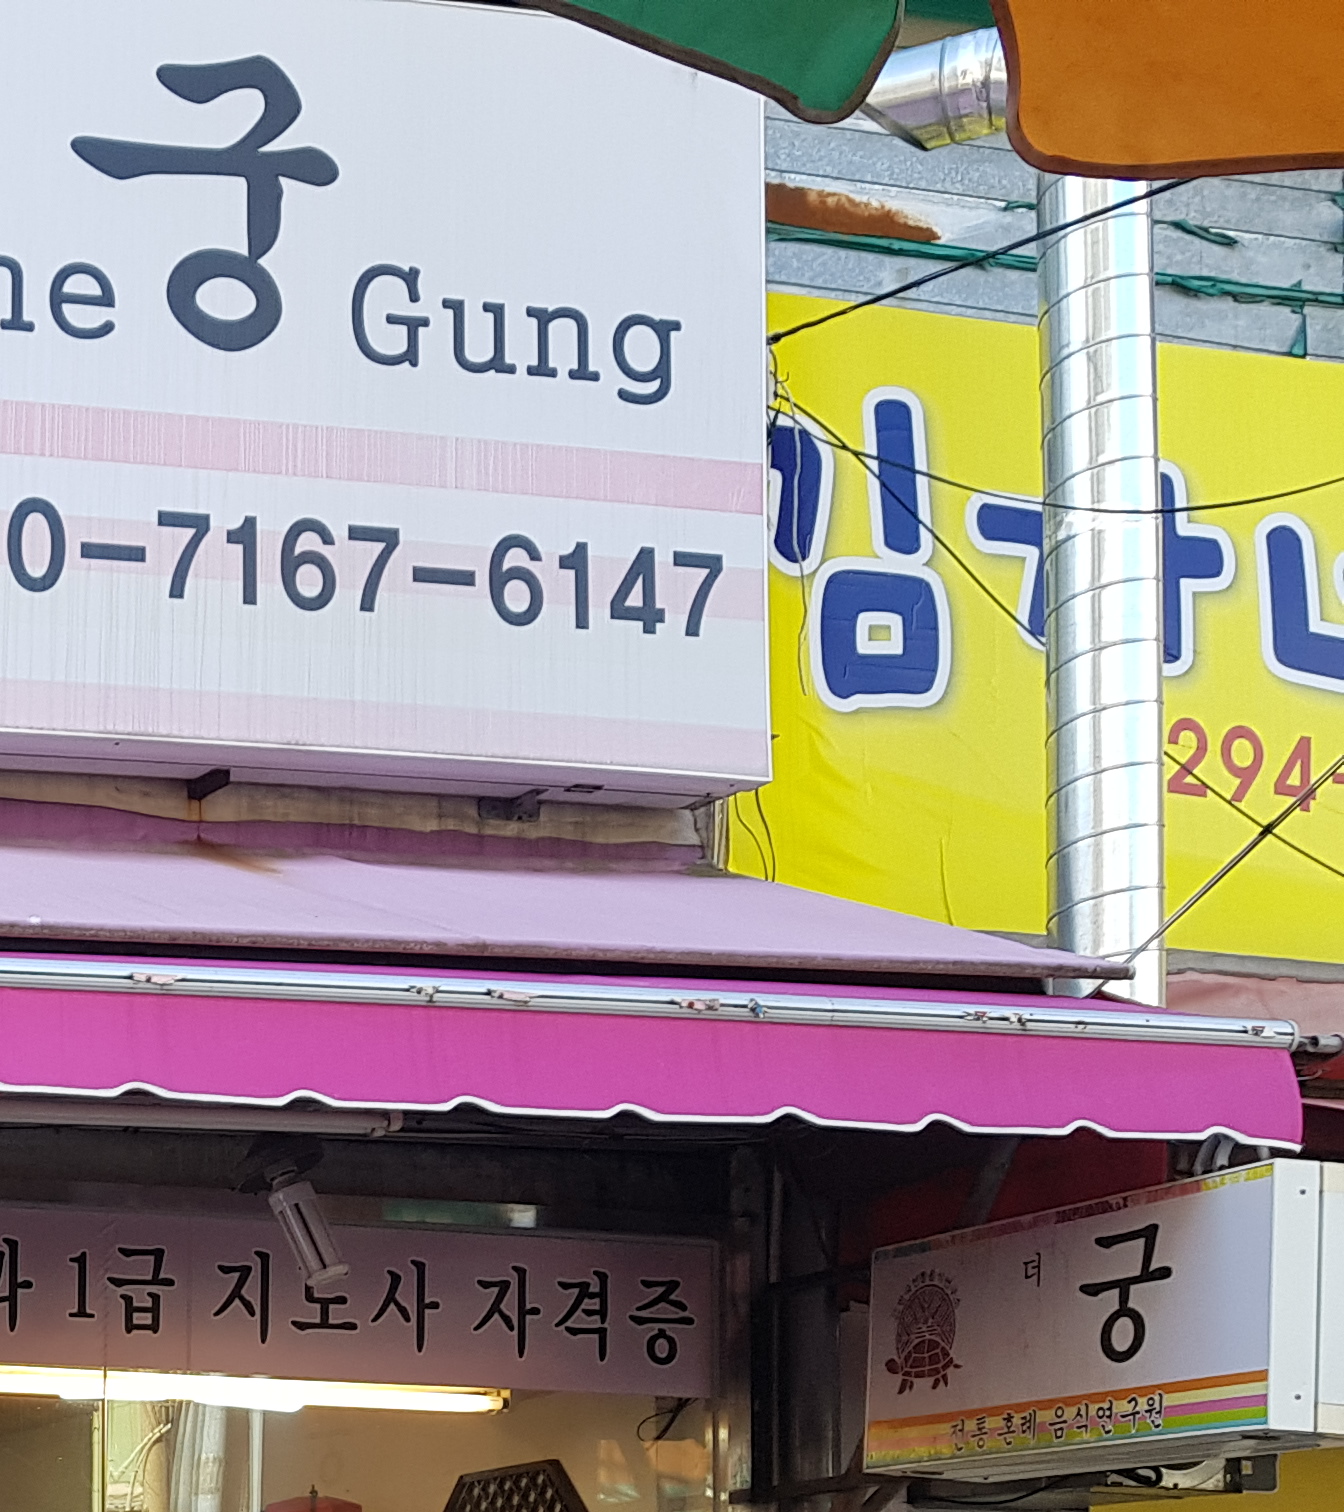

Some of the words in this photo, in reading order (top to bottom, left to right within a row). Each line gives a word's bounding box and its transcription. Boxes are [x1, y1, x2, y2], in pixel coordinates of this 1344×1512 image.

[70, 55, 340, 352] 궁
[351, 264, 682, 405] Gung
[66, 1247, 177, 1338] 1급
[472, 1265, 697, 1367] 자격증
[1022, 1252, 1042, 1288] 더
[1078, 1223, 1173, 1364] 궁
[950, 1415, 989, 1451] 전통
[997, 1409, 1037, 1446] 혼례
